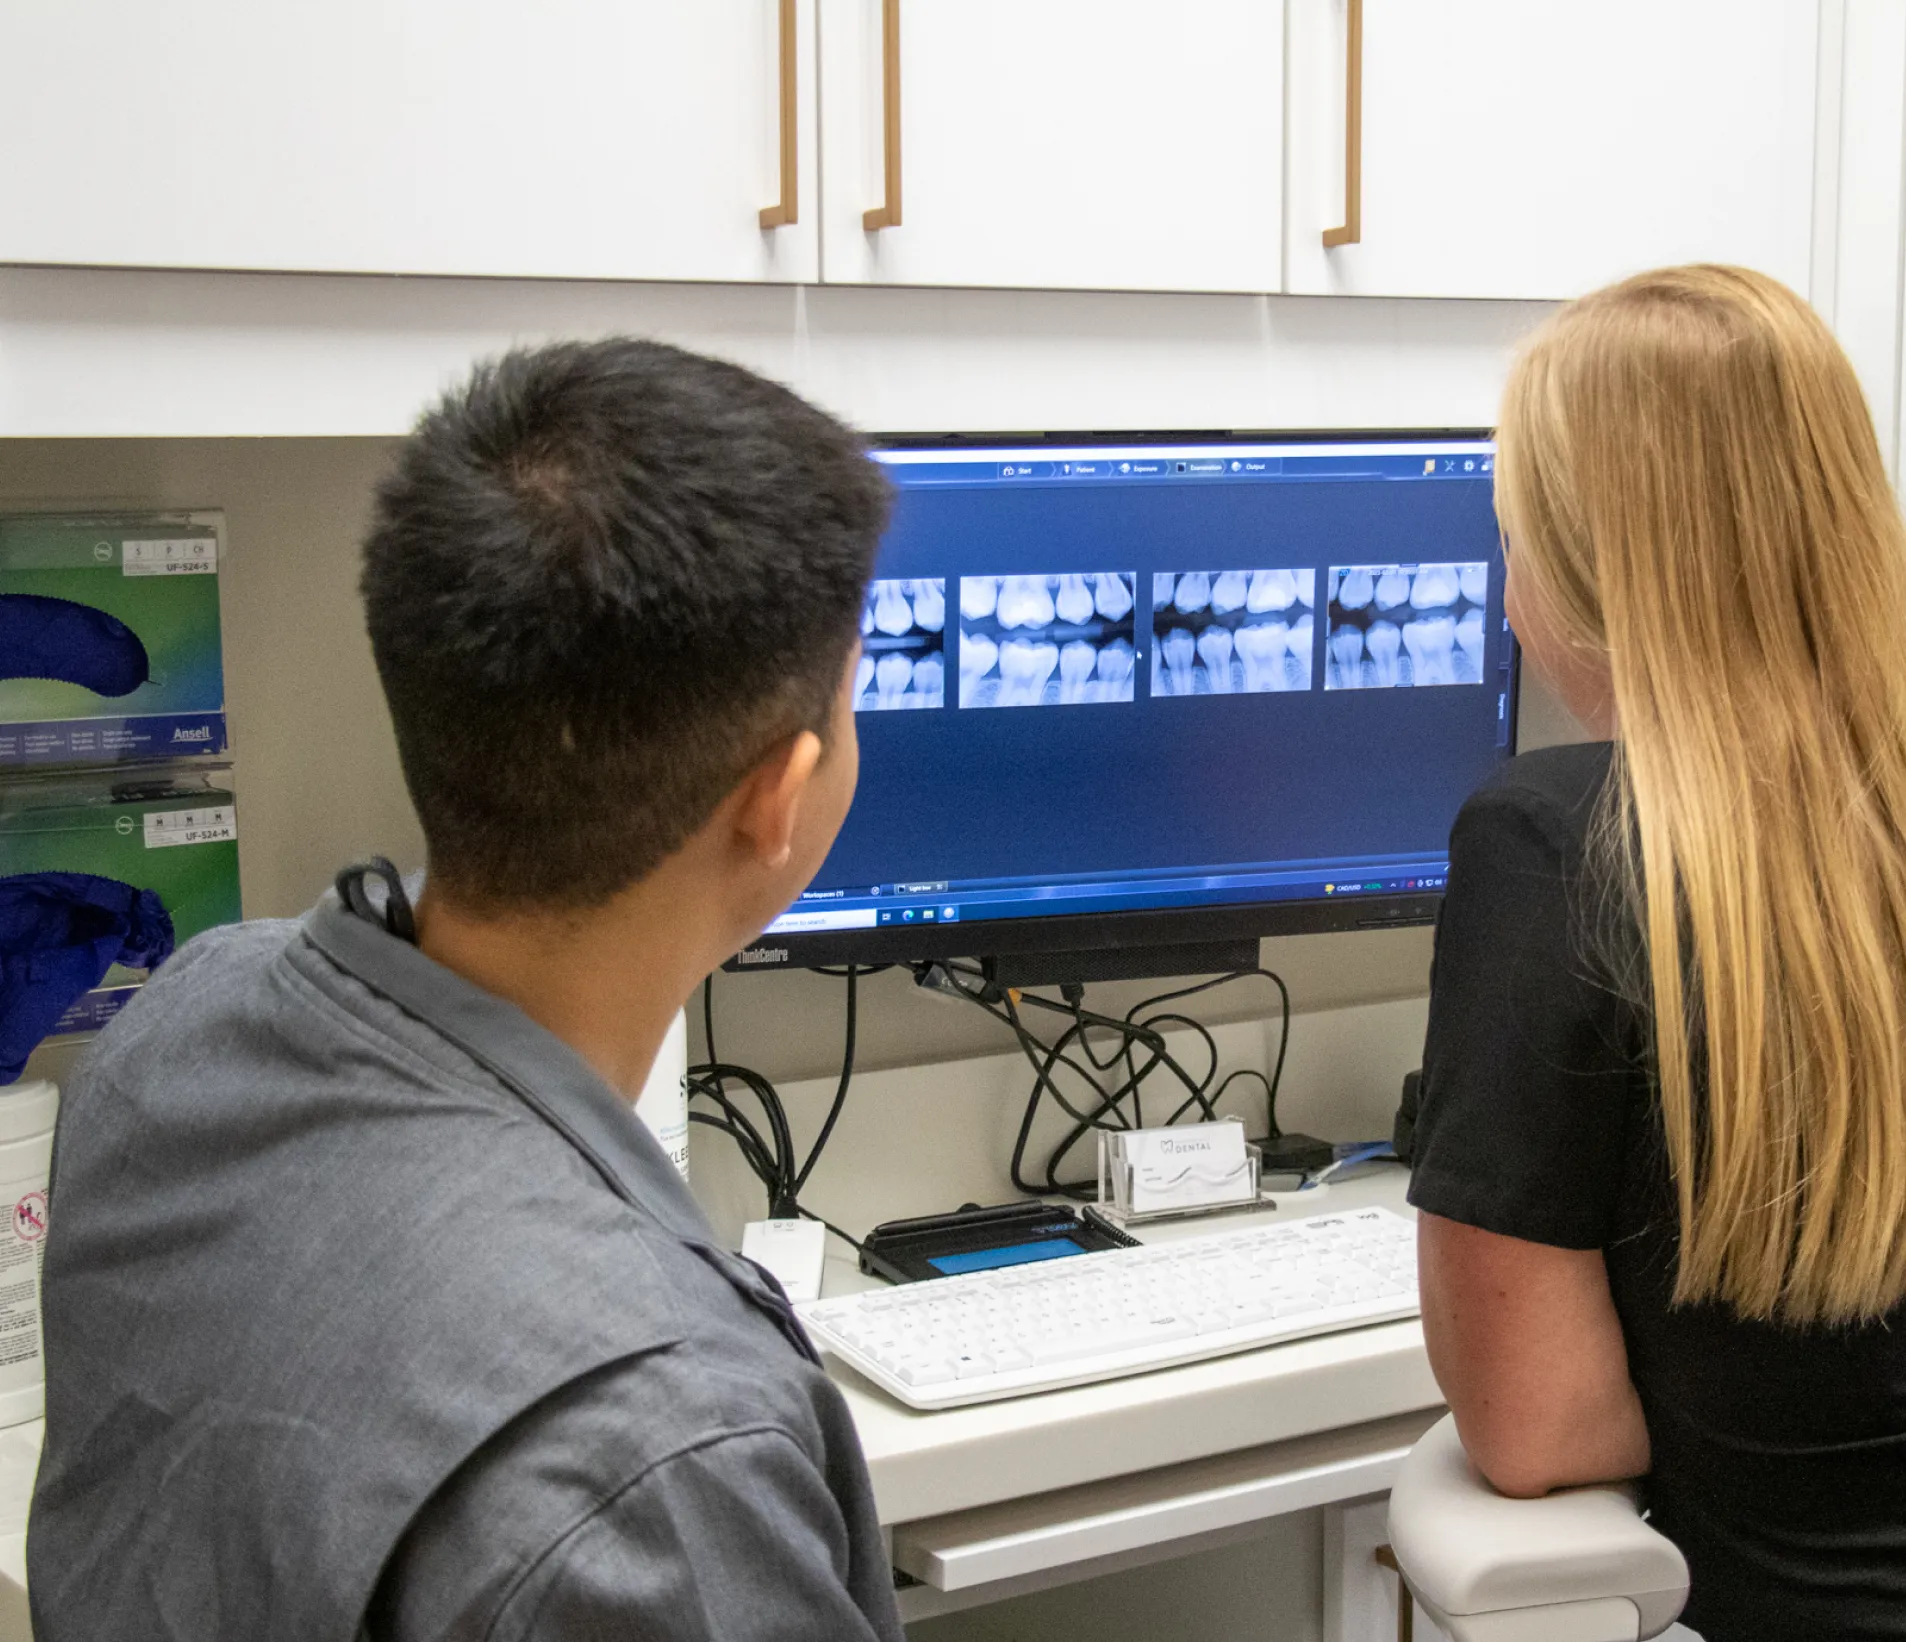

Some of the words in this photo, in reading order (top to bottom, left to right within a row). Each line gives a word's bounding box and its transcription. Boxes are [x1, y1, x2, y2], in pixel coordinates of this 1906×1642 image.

[166, 562, 209, 572] UF-524-S
[173, 726, 209, 740] Ansell
[156, 818, 163, 827] M
[186, 816, 193, 825] M
[215, 813, 222, 821] M
[185, 829, 229, 841] UF-524-M
[737, 948, 788, 964] ThinkCentre
[1175, 1142, 1211, 1154] DENTAL
